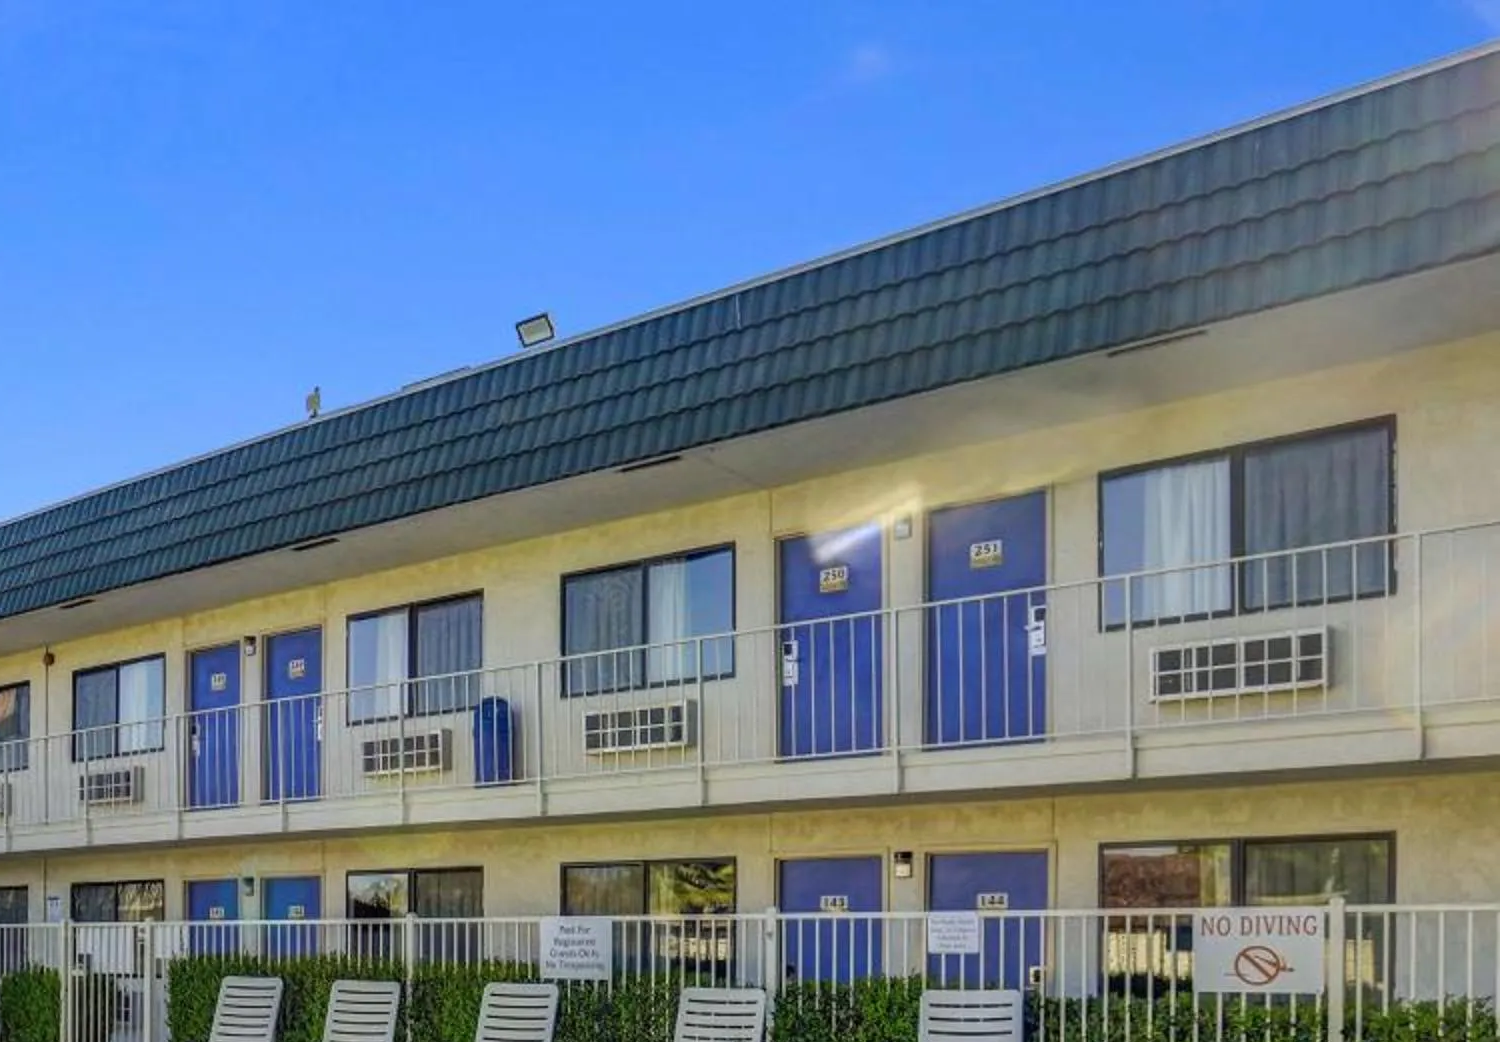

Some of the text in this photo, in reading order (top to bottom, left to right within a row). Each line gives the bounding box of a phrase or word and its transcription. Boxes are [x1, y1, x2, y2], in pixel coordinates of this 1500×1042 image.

[973, 543, 999, 557] 251
[823, 570, 846, 583] 250
[1201, 914, 1318, 936] NO DIVING
